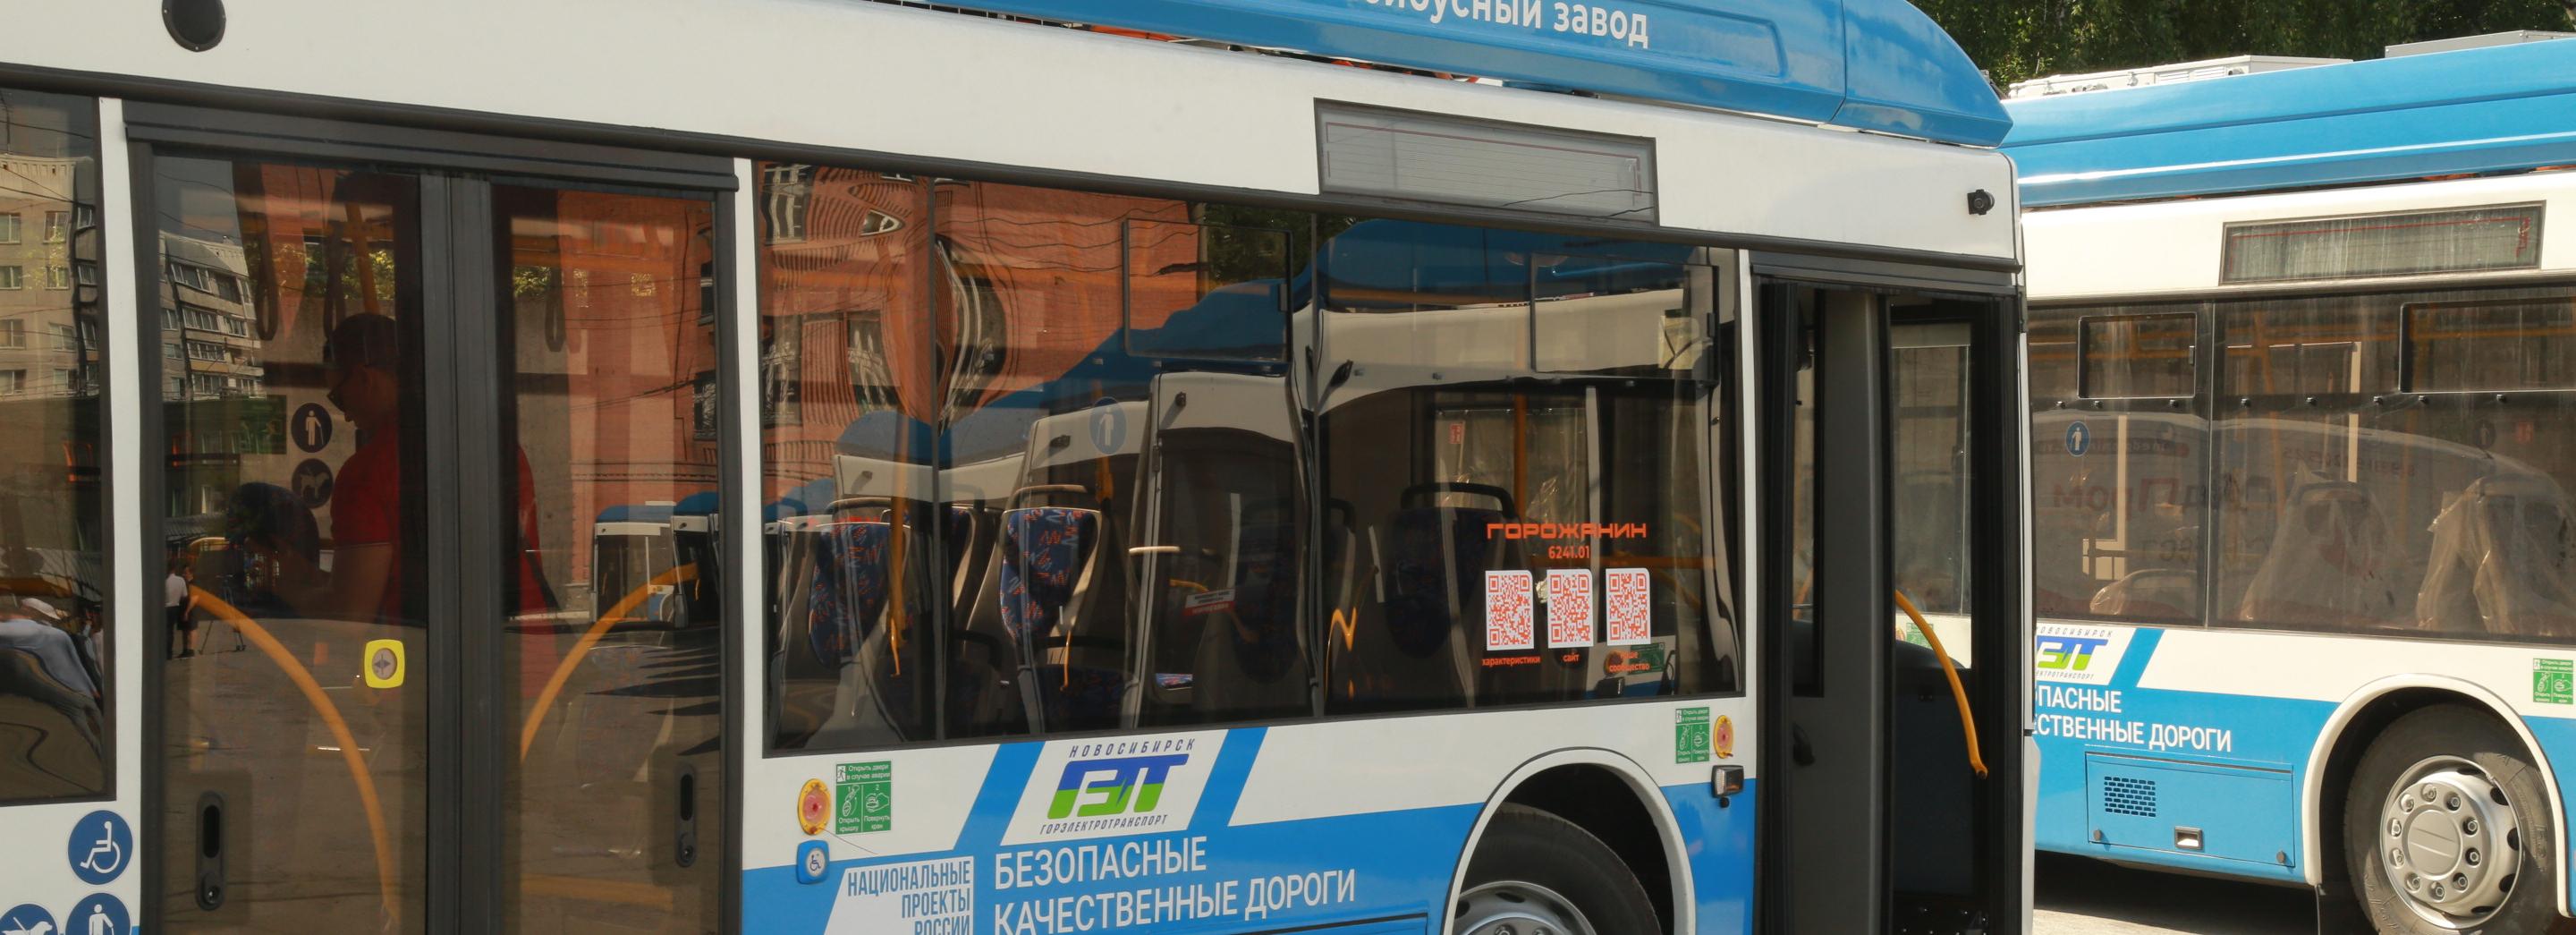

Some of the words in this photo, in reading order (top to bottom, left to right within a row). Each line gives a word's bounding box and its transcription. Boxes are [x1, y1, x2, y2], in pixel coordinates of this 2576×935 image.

[1554, 4, 1648, 49] завод
[1486, 523, 1647, 540] ГОРОЖАНИН
[1548, 546, 1590, 559] 6241.01
[1481, 655, 1541, 667] характеристики
[1563, 652, 1580, 663] сайт
[2035, 684, 2122, 713] ПАСНЫЕ
[1069, 738, 1196, 759] НОВОСИБИРСК
[2148, 723, 2232, 752] ДОРОГИ
[1046, 753, 1190, 820] ГЭТ
[1039, 814, 1168, 836] ГОРЭЛЕКТРОТРАНСПОРТ
[995, 836, 1207, 889] БЕЗОПАСНЫЕ
[848, 860, 970, 897] НАЦИОНАЛЬНЫЕ
[902, 888, 970, 918] ПРОЕКТЫ
[994, 880, 1238, 935] КАЧЕСТВЕННЫЕ
[1244, 869, 1355, 921] ДОРОГИ
[914, 914, 970, 935] РОССИИ
